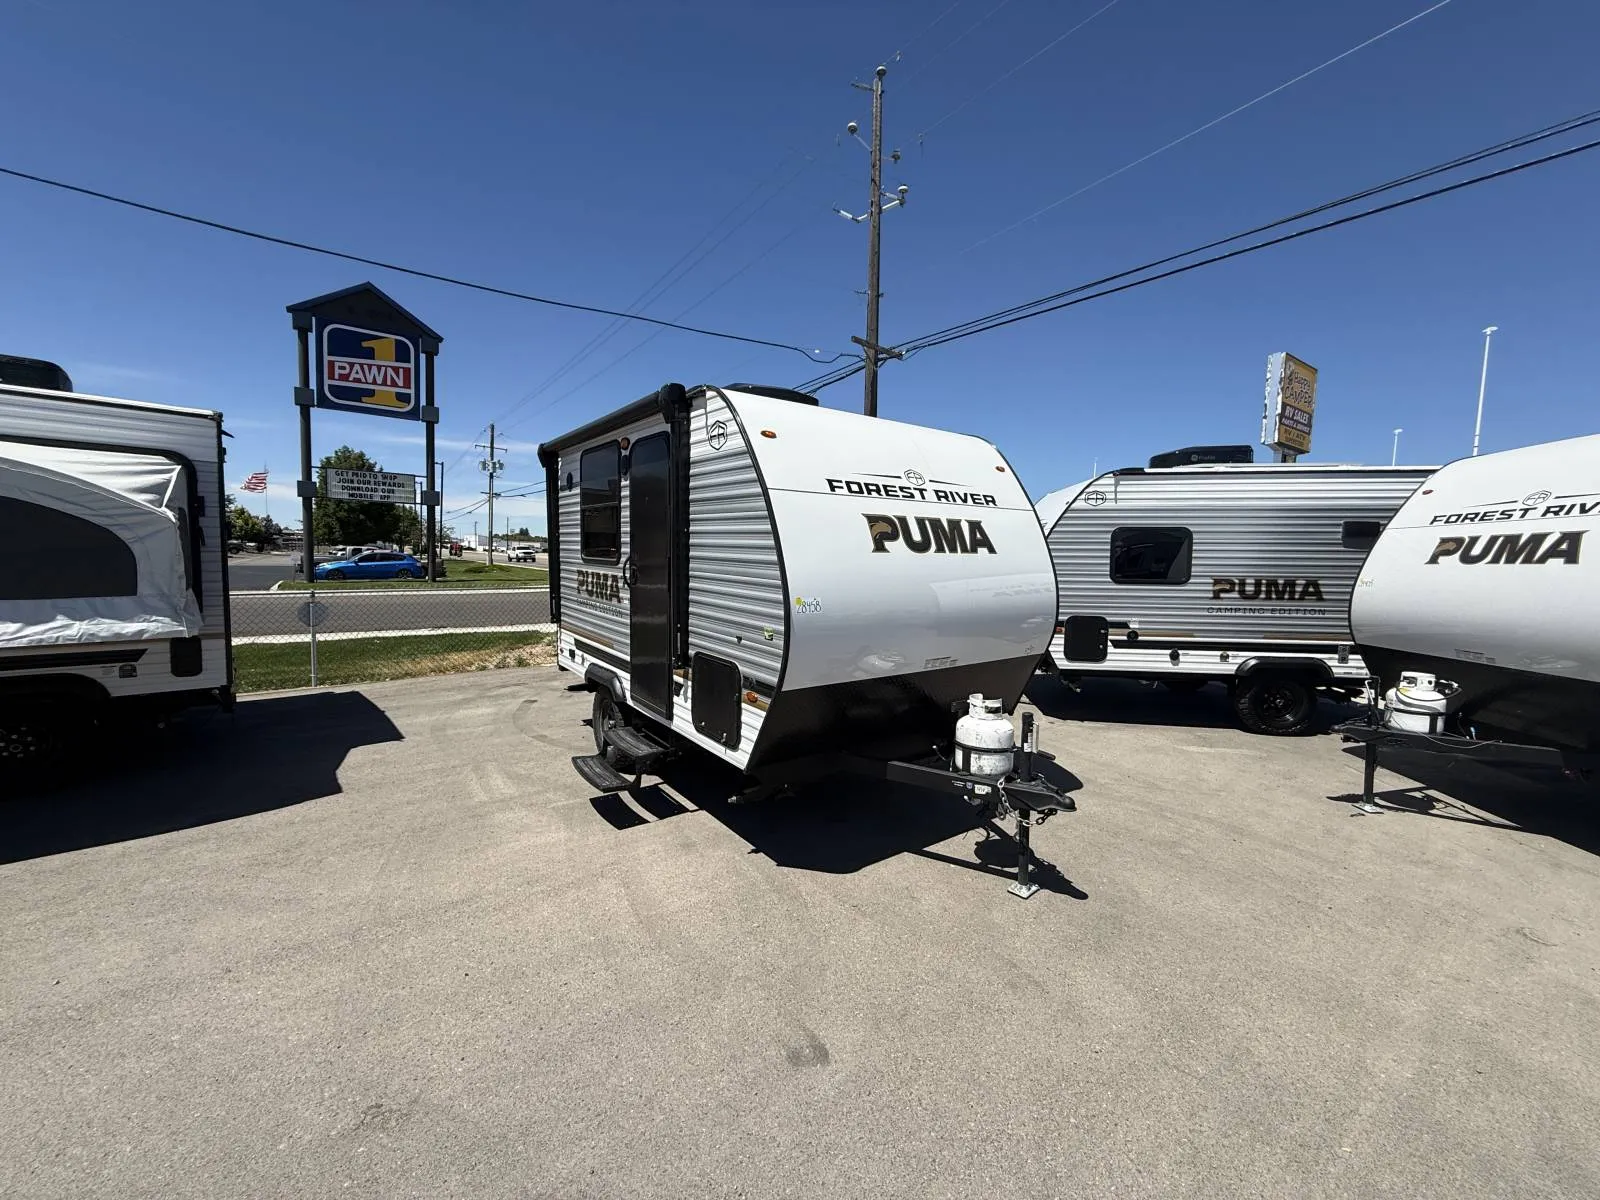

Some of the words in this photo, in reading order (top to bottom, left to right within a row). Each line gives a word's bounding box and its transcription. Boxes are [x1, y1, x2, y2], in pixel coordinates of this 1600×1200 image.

[334, 361, 404, 387] PAWN
[341, 485, 378, 493] DOWNLOAD
[825, 478, 927, 500] FOREST
[933, 489, 998, 506] RIVER
[1429, 507, 1538, 525] FOREST
[1540, 501, 1600, 517] RIV
[861, 513, 998, 555] PUMA
[1424, 530, 1590, 565] PUMA
[576, 570, 621, 603] PUMA
[1209, 577, 1326, 601] PUMA
[1206, 607, 1264, 615] CAMPING
[1271, 607, 1328, 616] EDITION
